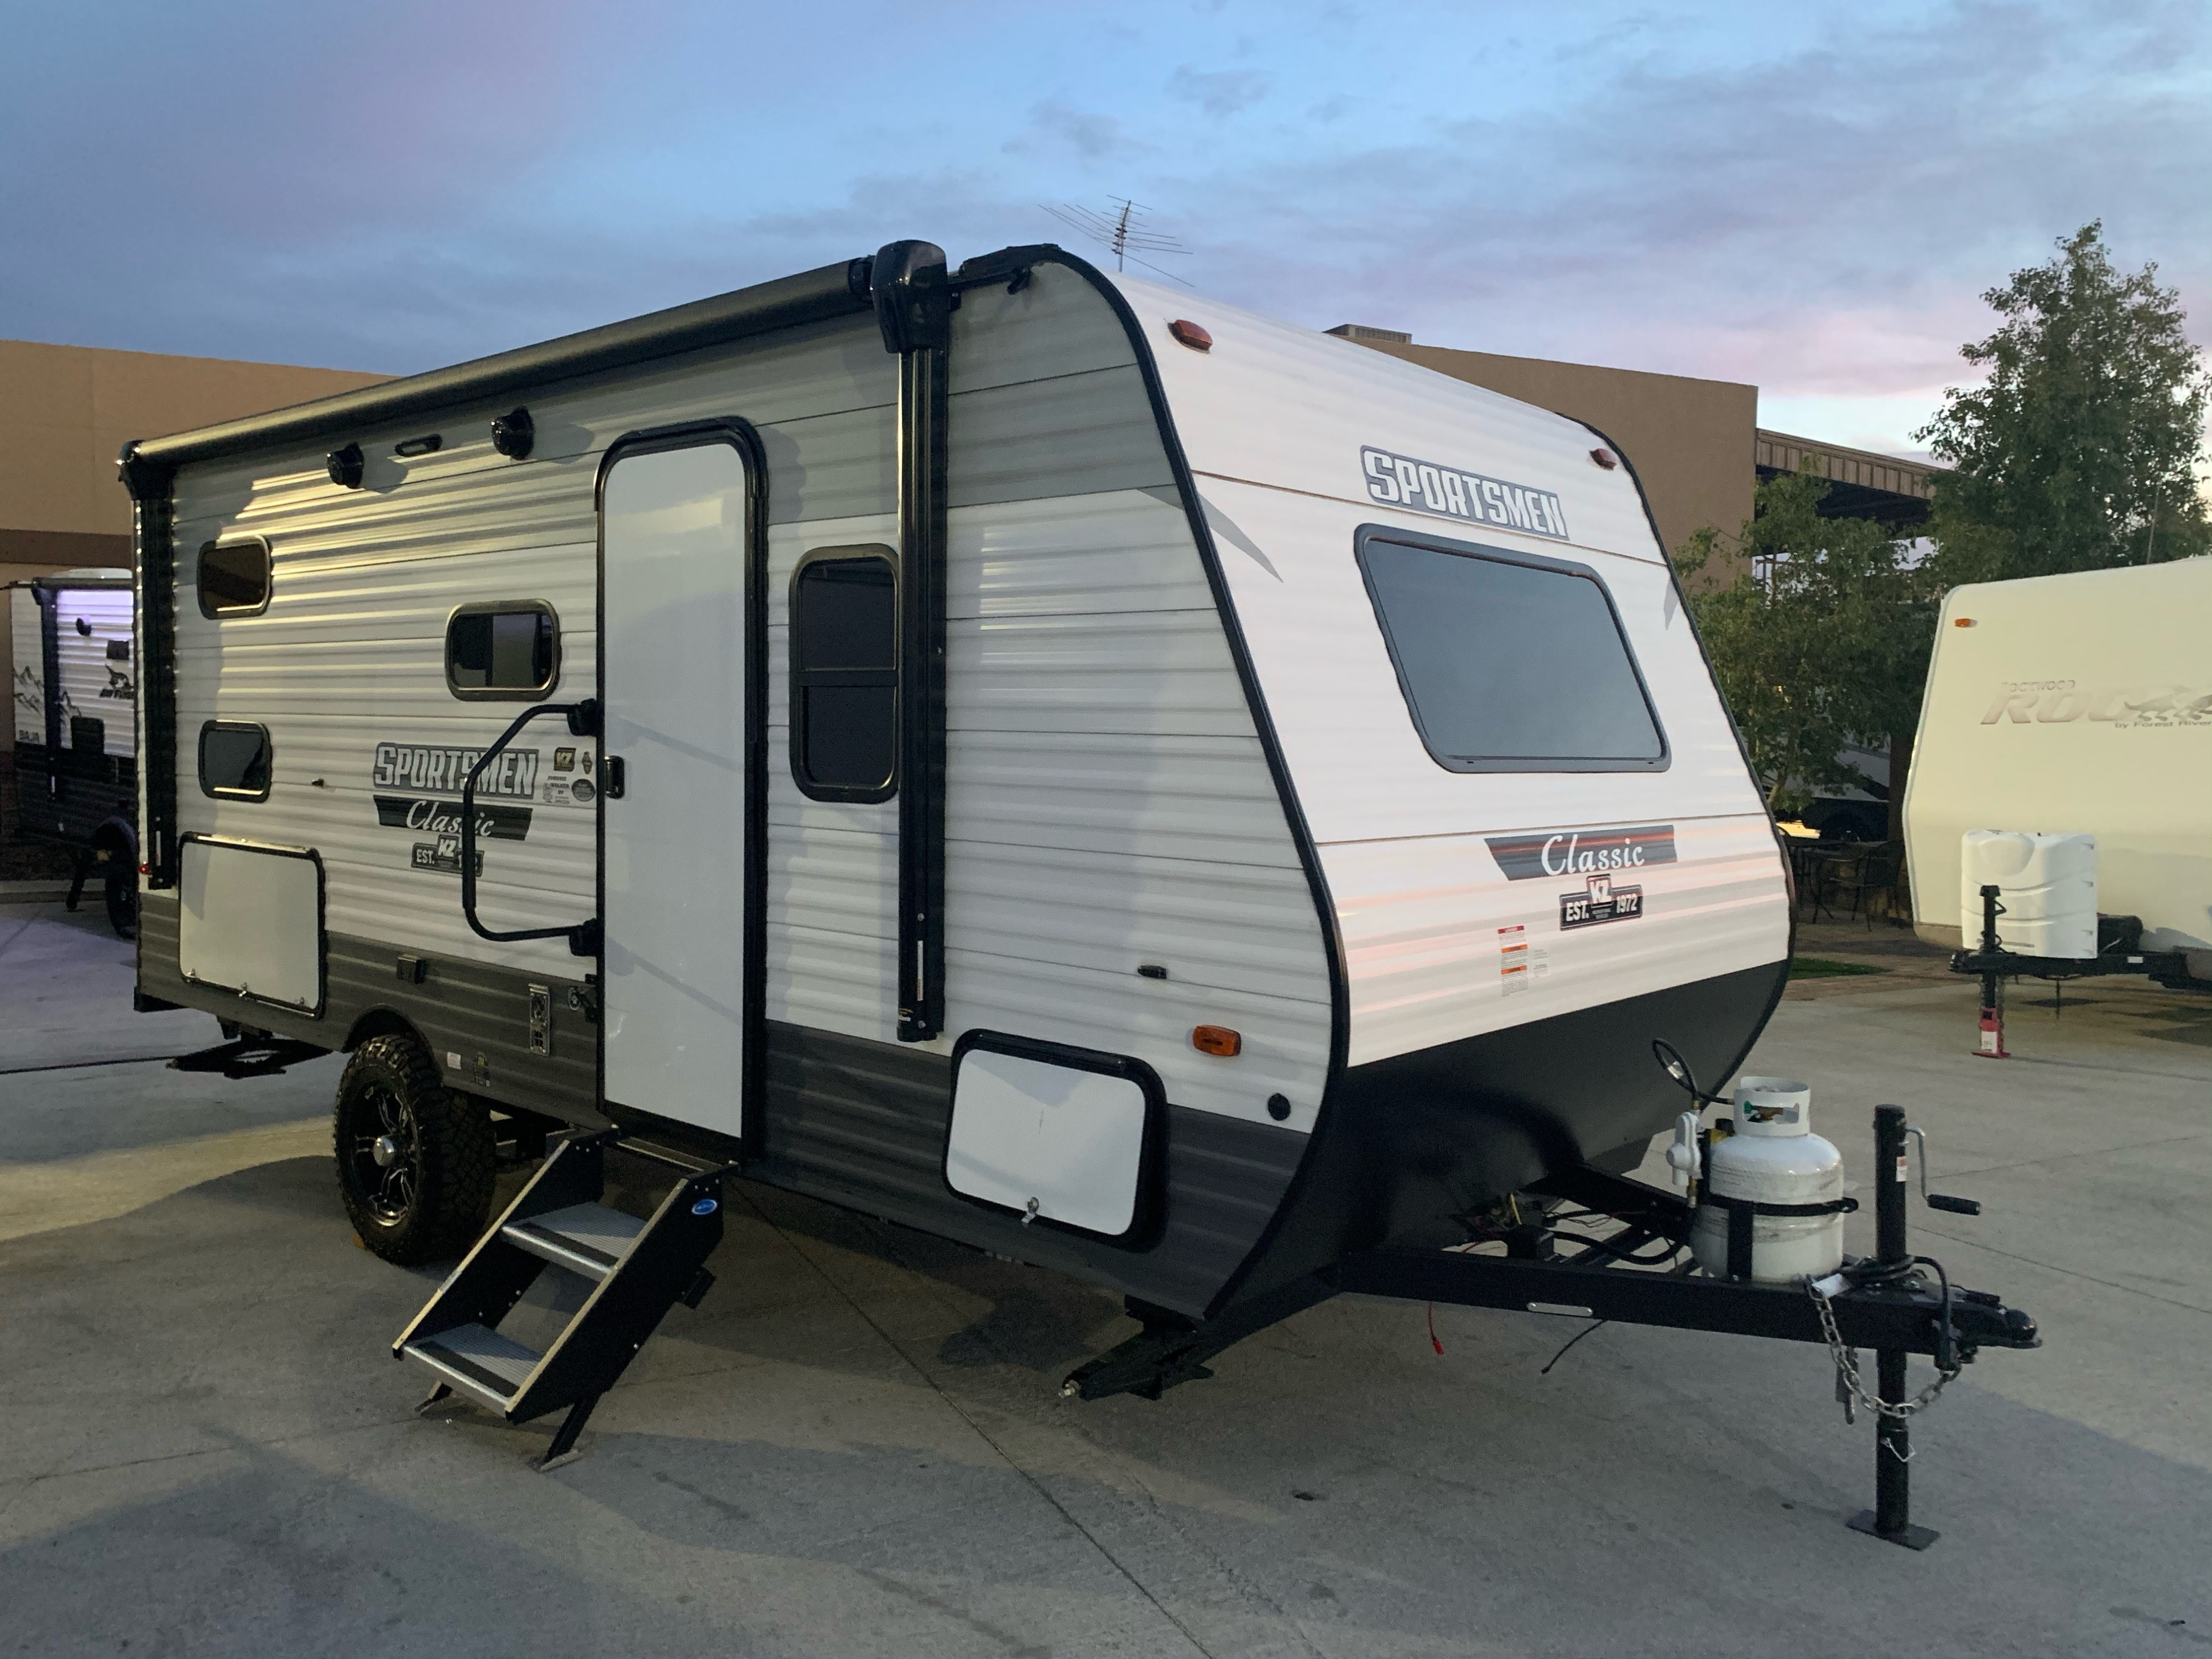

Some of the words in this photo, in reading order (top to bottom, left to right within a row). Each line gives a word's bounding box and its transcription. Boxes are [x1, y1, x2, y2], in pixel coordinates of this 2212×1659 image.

[1363, 450, 1567, 537] SPORTSMEN
[374, 747, 536, 795] SPORTSMEN
[406, 801, 494, 836] Clasic
[416, 849, 435, 864] EST.
[438, 839, 457, 857] KZ
[1541, 834, 1645, 875] Classic
[1566, 900, 1590, 922] EST.
[1616, 893, 1637, 914] 1972
[1589, 880, 1612, 903] KZ
